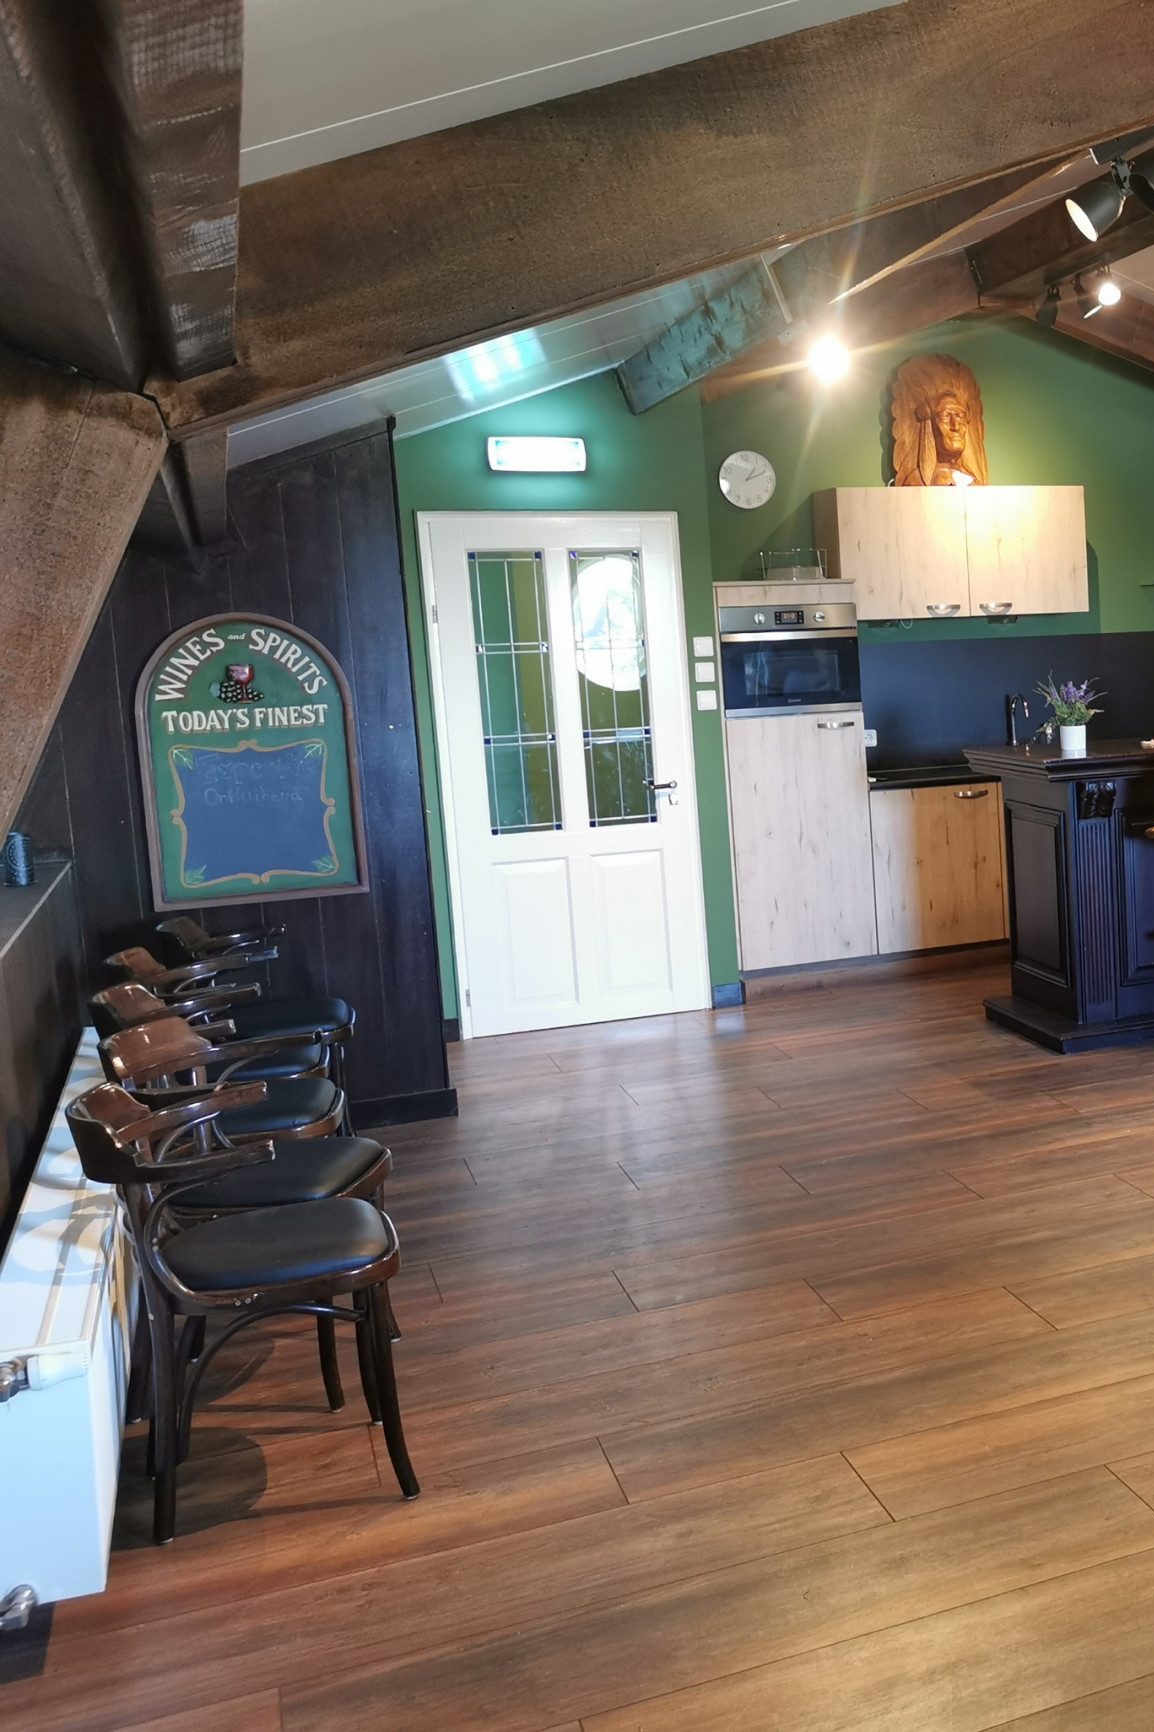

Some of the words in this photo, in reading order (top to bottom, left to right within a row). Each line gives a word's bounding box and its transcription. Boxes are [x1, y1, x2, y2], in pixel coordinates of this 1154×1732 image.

[155, 628, 225, 701] WINES
[227, 632, 246, 641] and
[249, 628, 328, 695] SPIRITS
[161, 707, 250, 733] TODAY'S
[253, 703, 328, 728] FINEST
